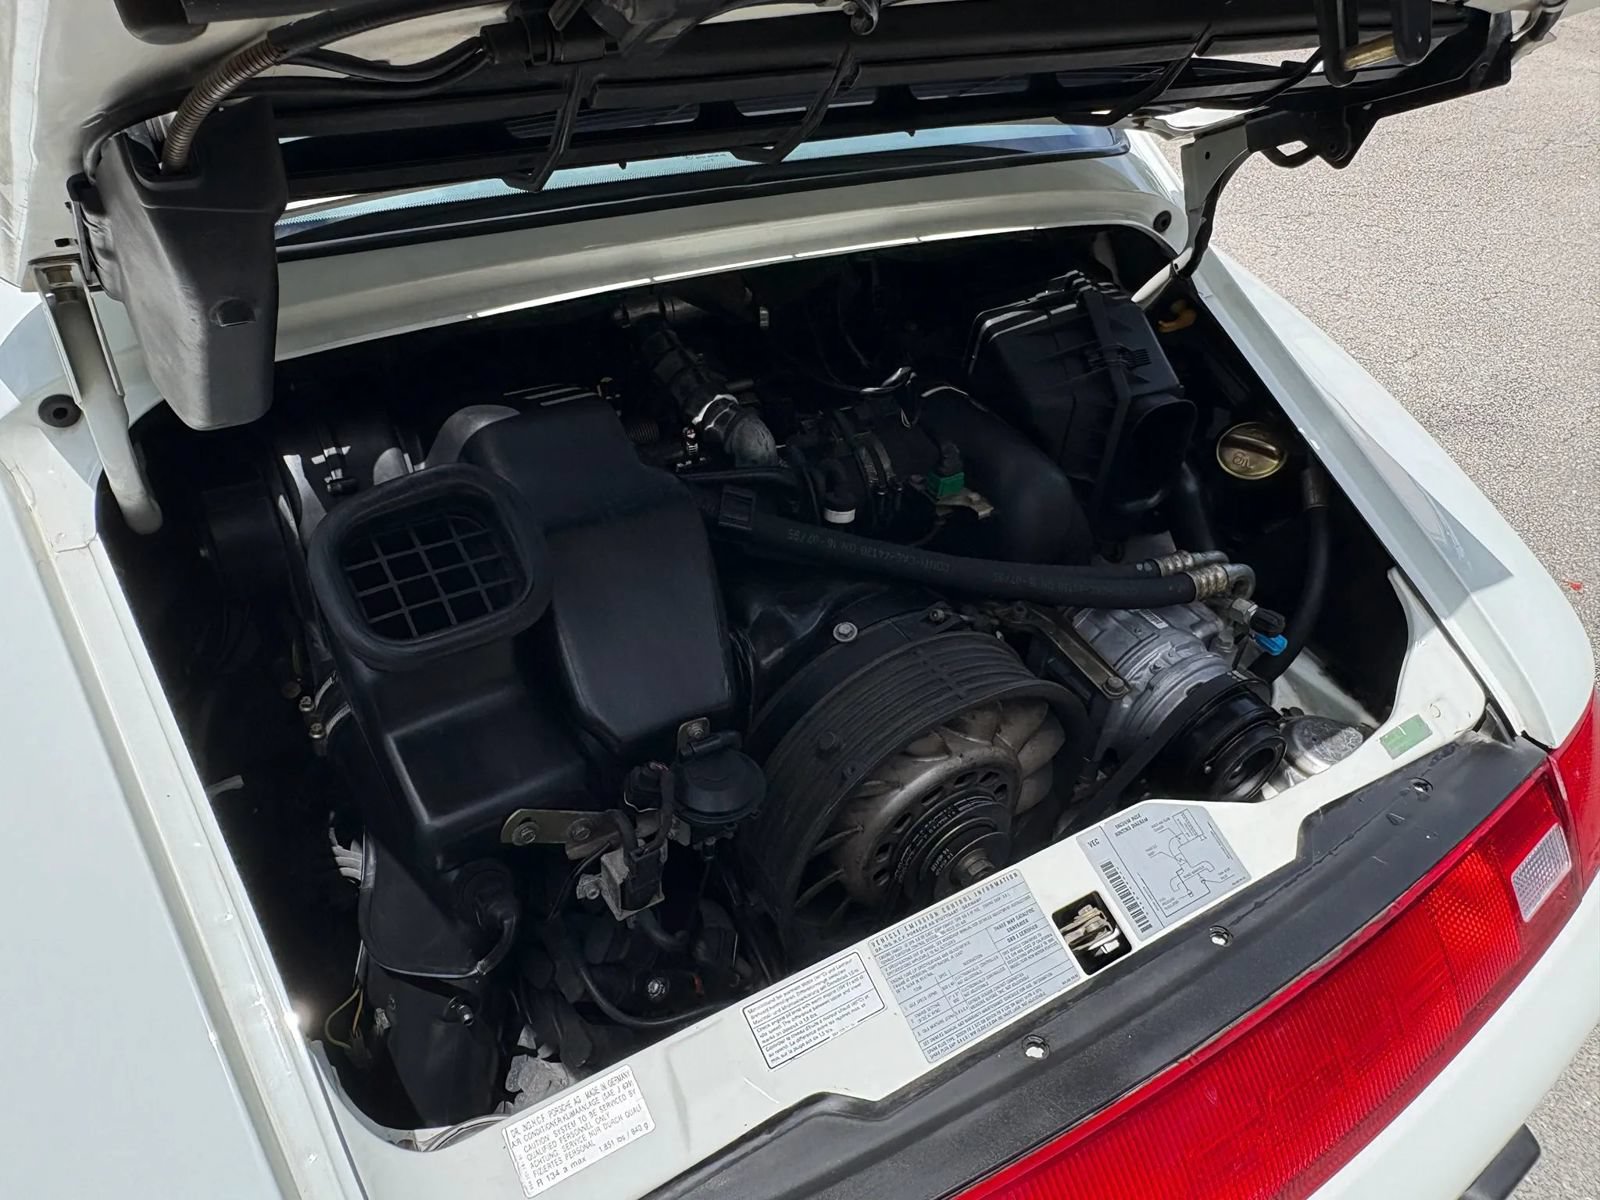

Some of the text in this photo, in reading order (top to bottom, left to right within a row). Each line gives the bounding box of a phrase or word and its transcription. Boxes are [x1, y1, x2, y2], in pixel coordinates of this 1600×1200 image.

[1087, 838, 1100, 848] VEC
[870, 929, 901, 947] VEHICLE
[903, 910, 939, 931] EMISSION
[940, 894, 972, 913] CONTROL
[973, 872, 1018, 897] INFORMATION
[552, 1119, 577, 1137] SYSTEM
[597, 1093, 627, 1113] SERVICED
[560, 1133, 587, 1152] SERVICE
[587, 1125, 601, 1138] NUR
[602, 1113, 623, 1130] DURCH
[525, 1111, 611, 1162] QUALIFIED PERSONNEL ONLY
[532, 1156, 563, 1178] FIZIERTES
[563, 1138, 595, 1161] PERSONAL
[545, 1169, 560, 1182] 134
